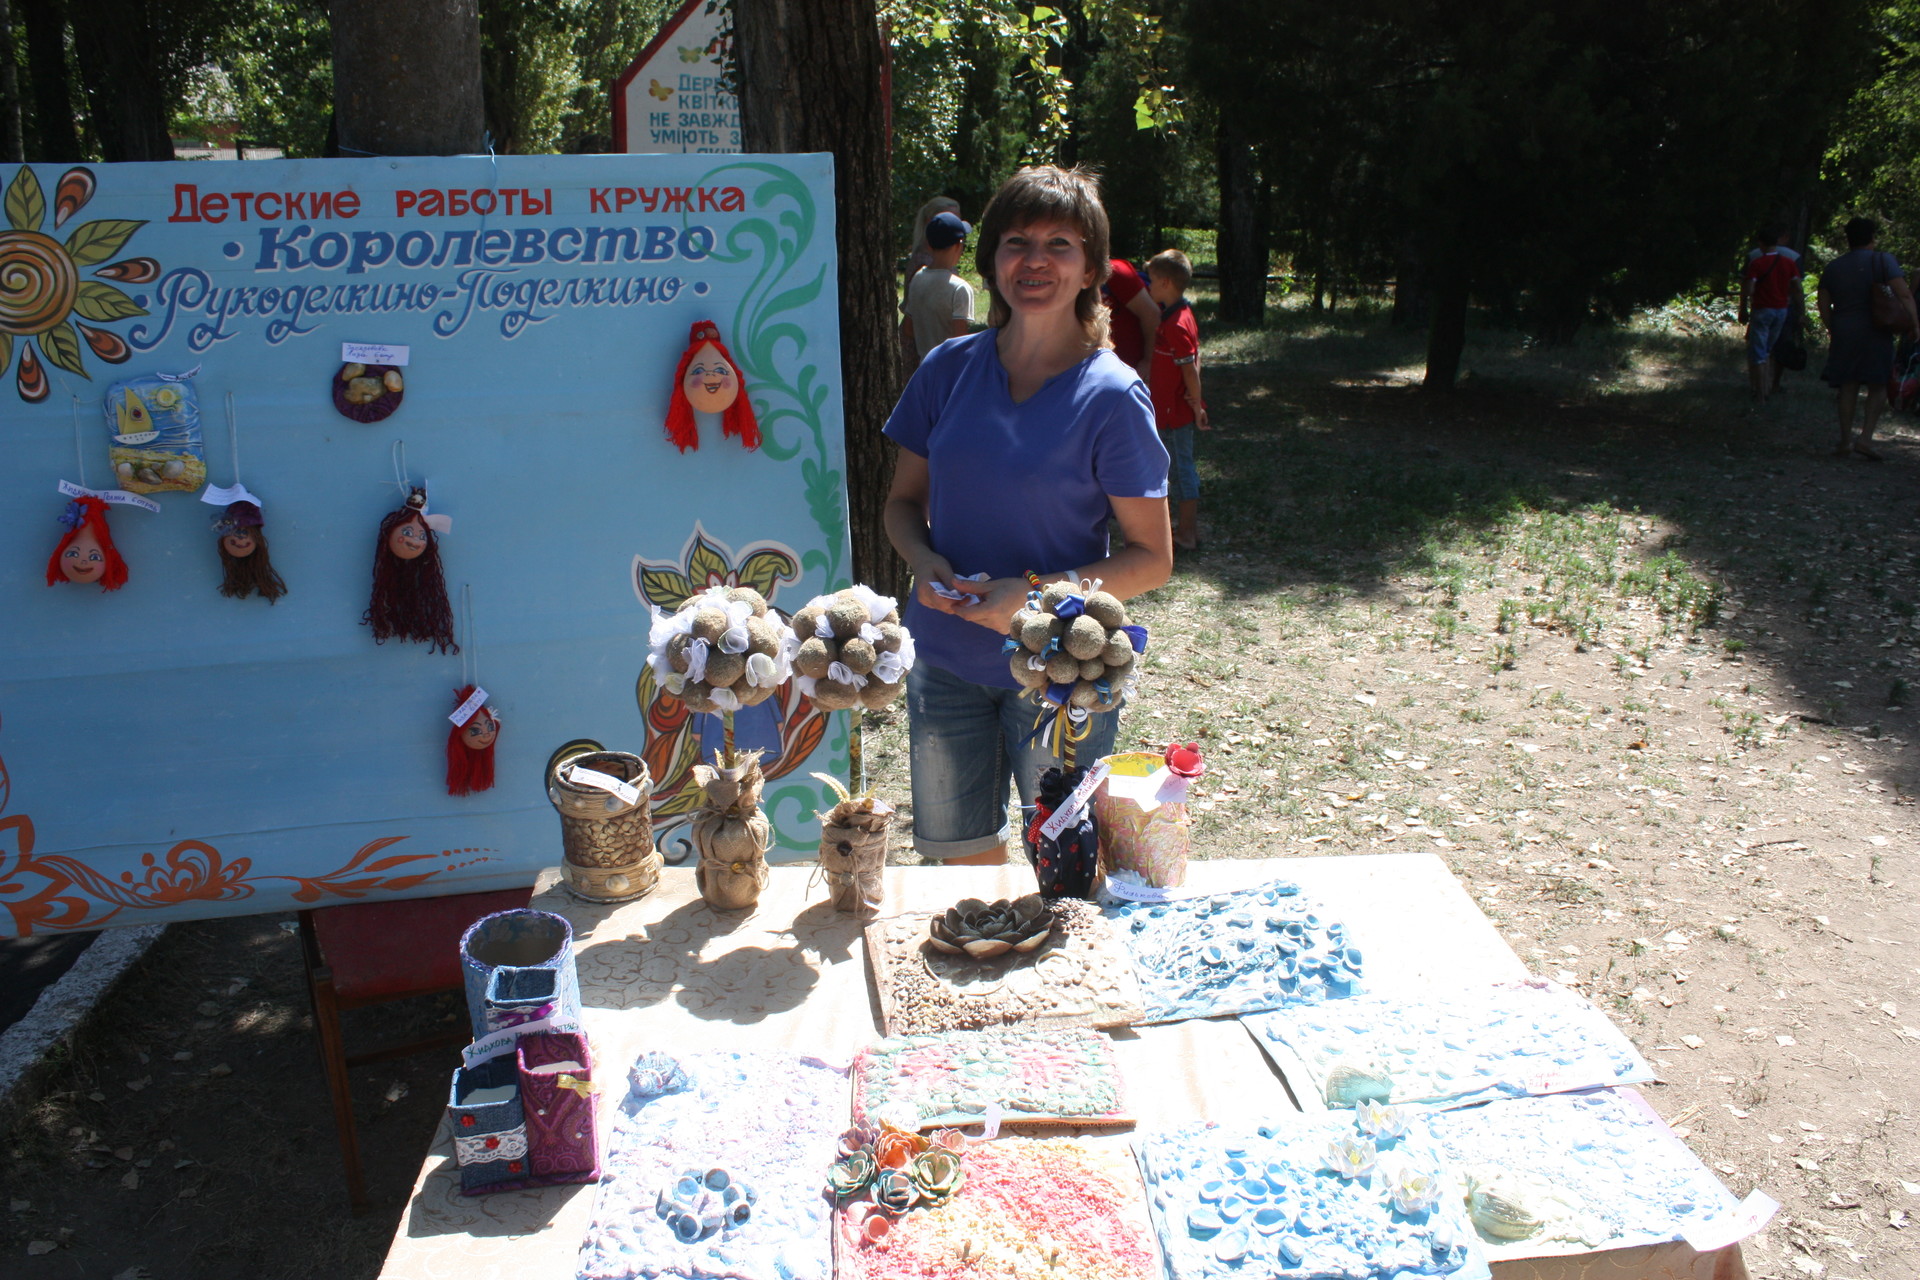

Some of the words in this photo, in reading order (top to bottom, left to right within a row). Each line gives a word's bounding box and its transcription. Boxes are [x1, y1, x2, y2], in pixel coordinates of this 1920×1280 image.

[650, 113, 670, 127] НЕ
[679, 113, 741, 128] ЗАВЖД
[650, 128, 719, 144] УМІЮТЬ
[168, 184, 361, 224] Детские
[395, 188, 552, 217] работы
[589, 186, 745, 213] кружка
[254, 224, 716, 274] Королевство
